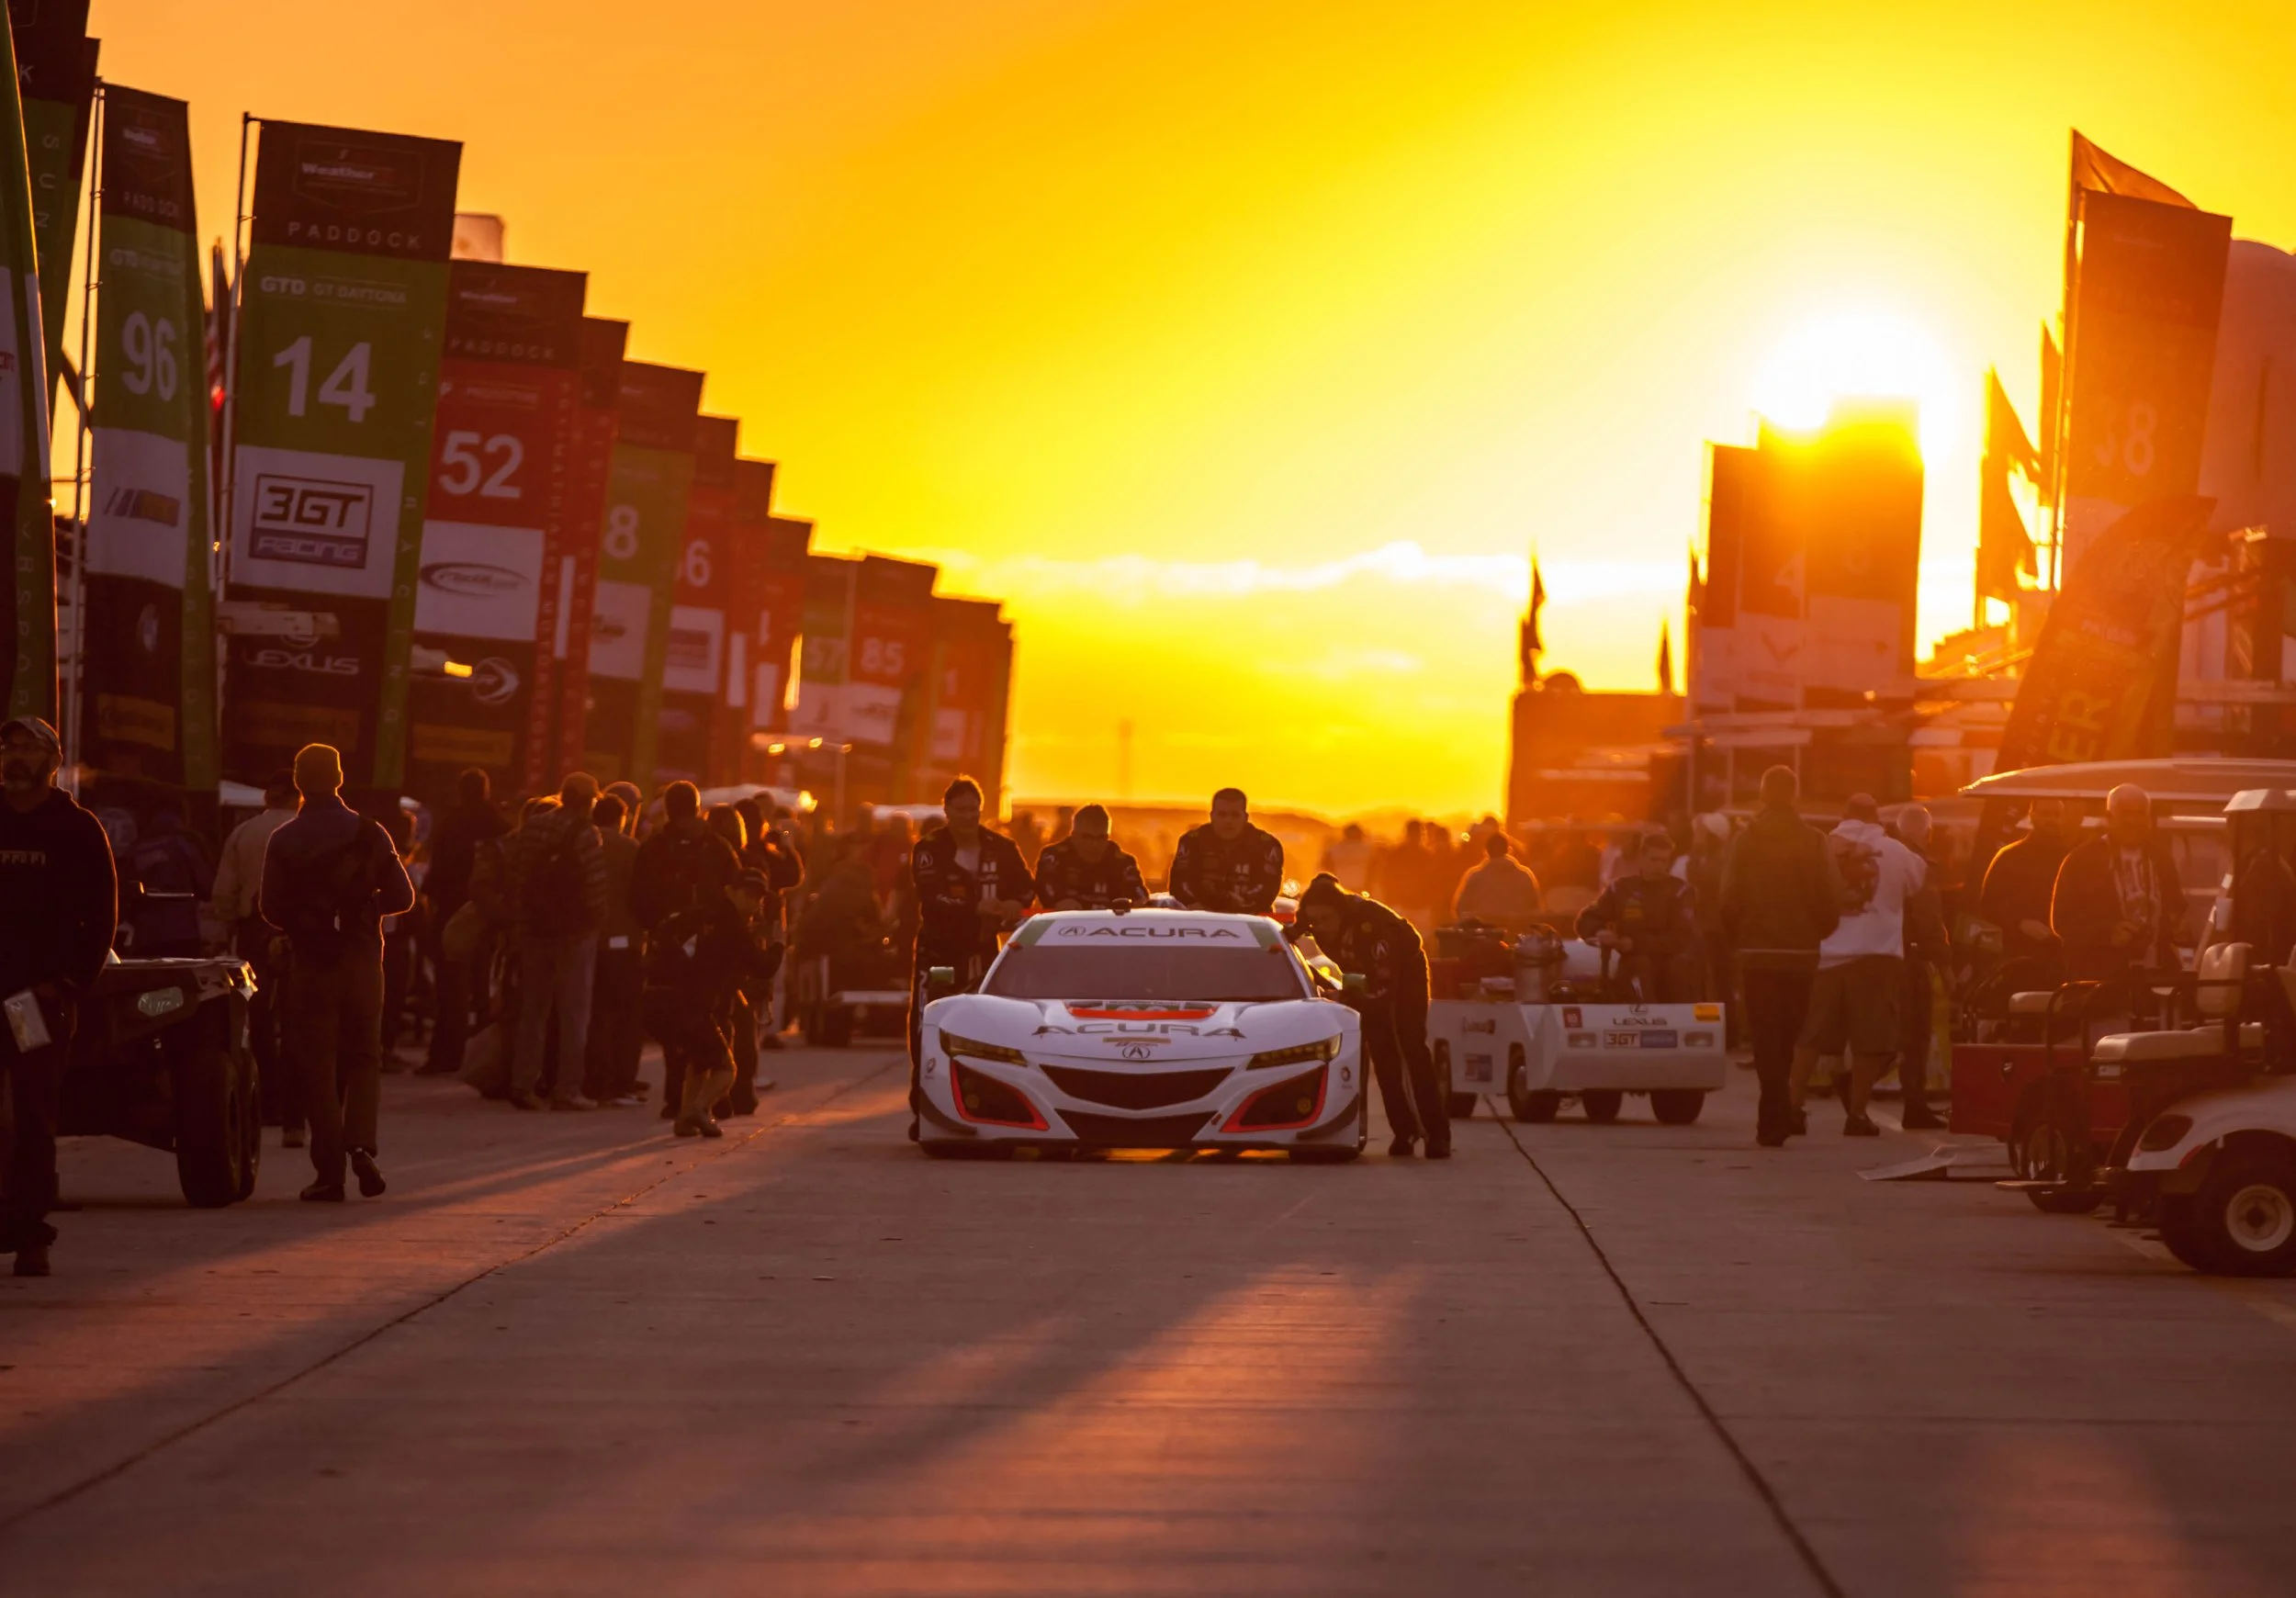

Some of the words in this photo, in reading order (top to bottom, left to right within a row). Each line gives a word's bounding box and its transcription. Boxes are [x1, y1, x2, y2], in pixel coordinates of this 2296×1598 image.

[287, 220, 422, 250] PADDOCK
[260, 276, 307, 296] GTD
[312, 282, 334, 297] GT
[337, 286, 407, 304] DAYTONA
[121, 310, 177, 401] 96
[449, 336, 555, 361] PADDOCK
[272, 334, 377, 424] 14
[437, 430, 525, 499] 52
[259, 485, 366, 528] 3GT
[603, 504, 640, 559] 8
[257, 535, 362, 561] RACING
[685, 537, 713, 587] 6
[242, 646, 361, 676] LEXUS
[861, 636, 905, 677] 85
[1086, 927, 1241, 939] ACURA
[1031, 1022, 1247, 1040] ACURA
[1612, 1017, 1668, 1026] LEXUS
[1606, 1032, 1638, 1045] 3GT
